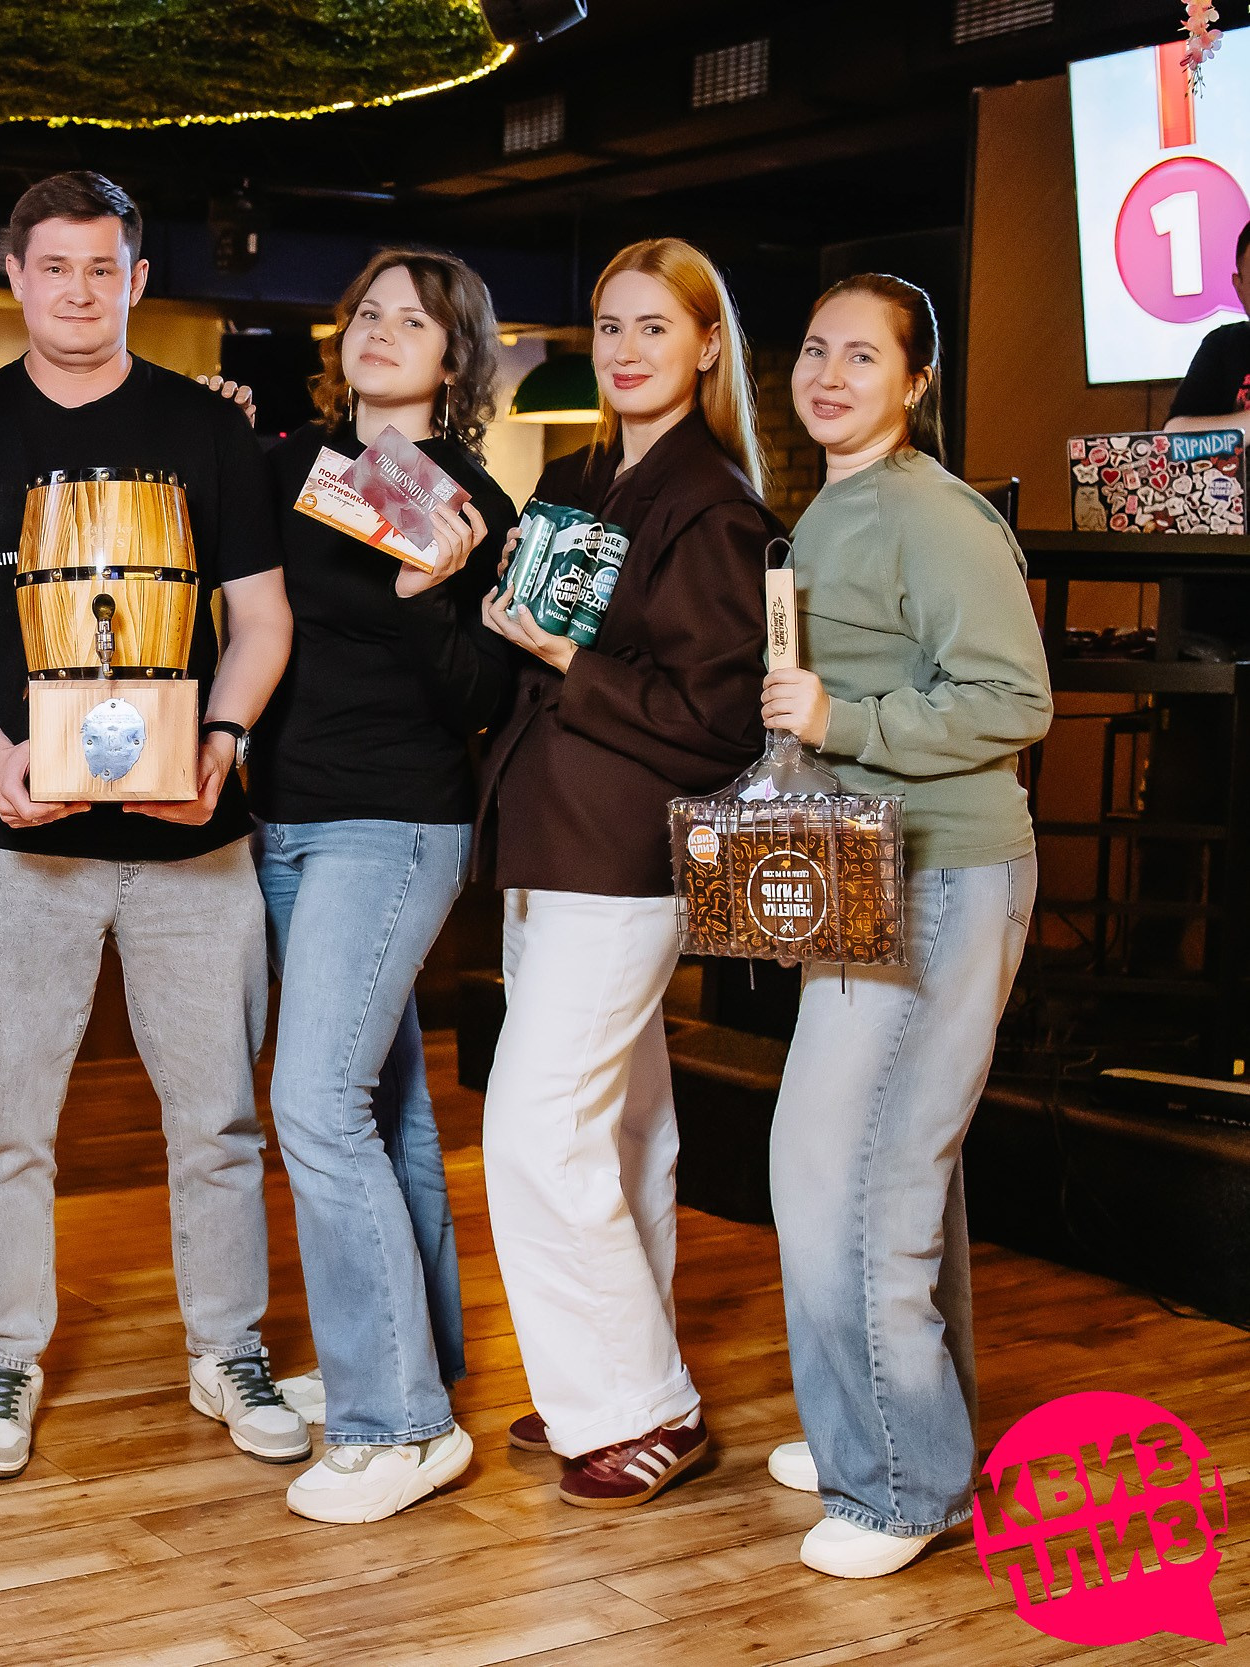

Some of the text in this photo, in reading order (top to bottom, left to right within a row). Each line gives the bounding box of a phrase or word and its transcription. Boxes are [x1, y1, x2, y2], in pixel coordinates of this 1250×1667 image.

[1150, 190, 1203, 297] 1
[1172, 433, 1238, 460] RIPNDIP
[318, 468, 352, 488] ПОДА
